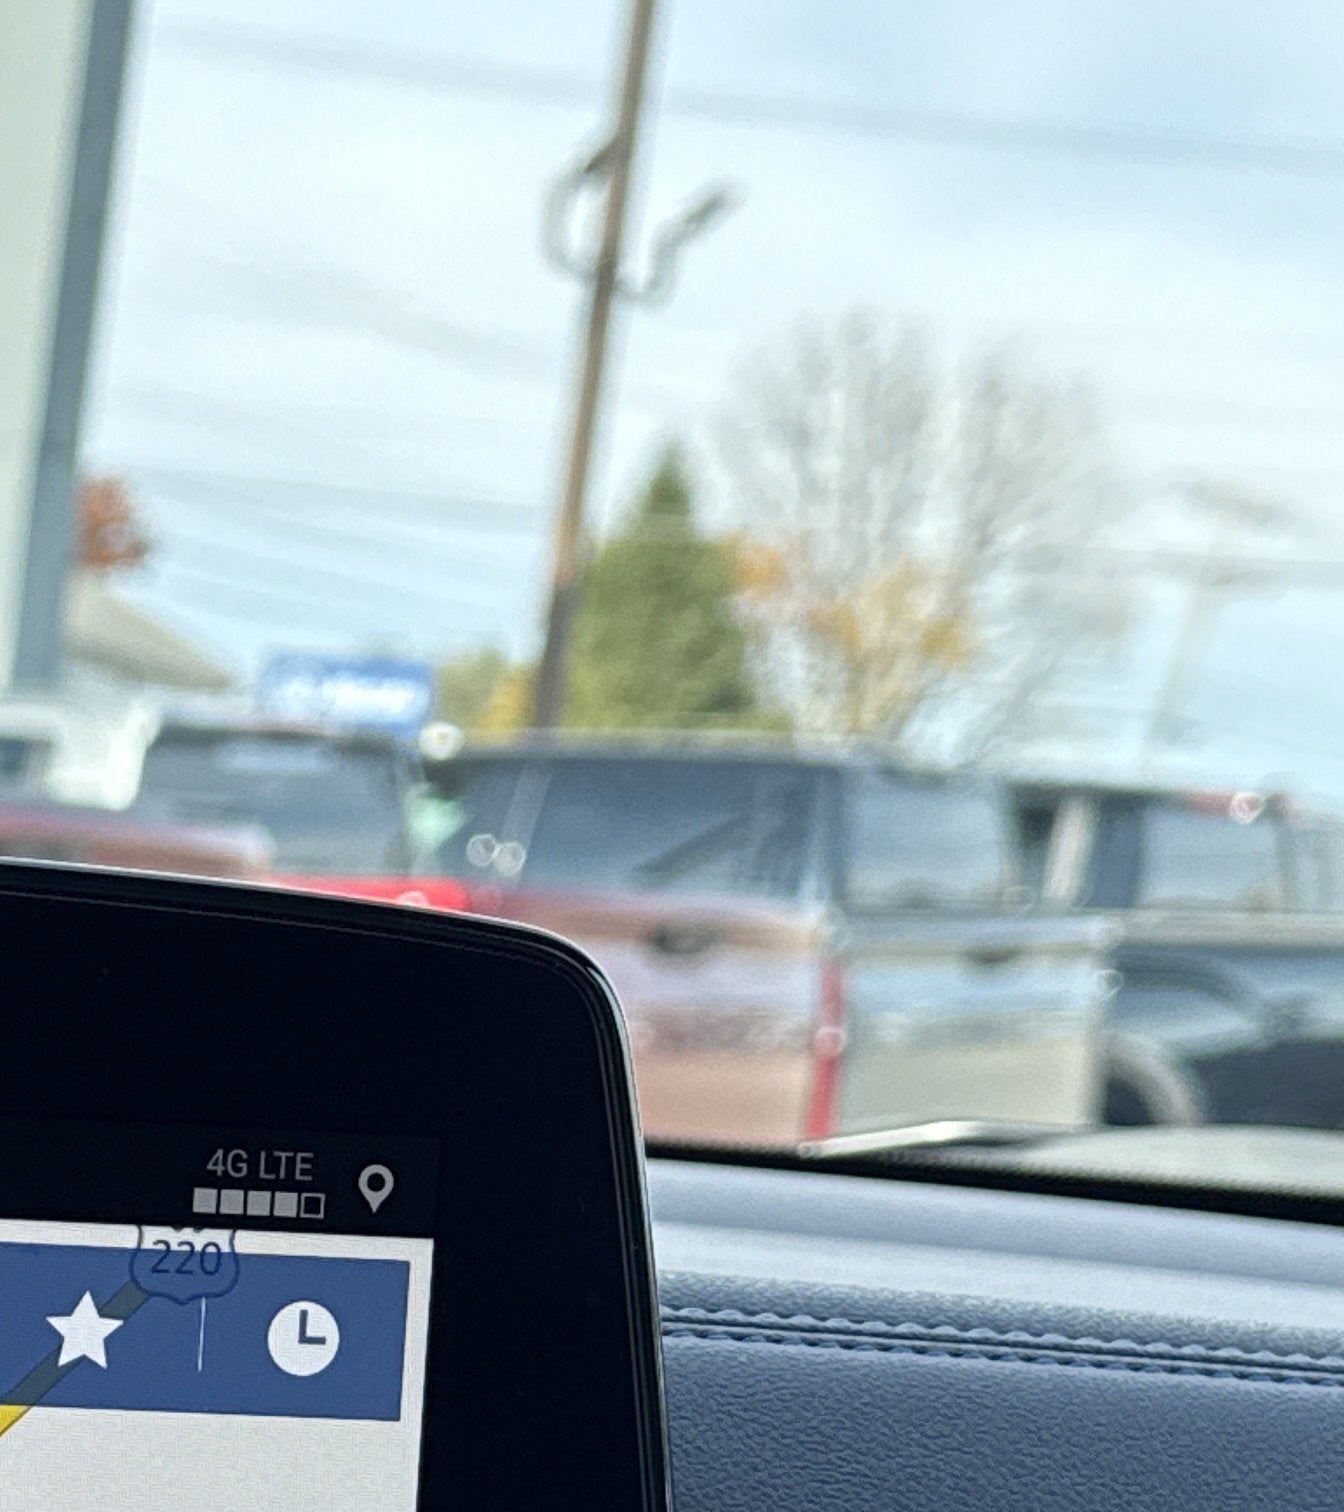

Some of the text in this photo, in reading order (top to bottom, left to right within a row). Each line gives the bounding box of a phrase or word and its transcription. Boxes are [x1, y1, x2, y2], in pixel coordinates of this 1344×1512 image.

[206, 1148, 315, 1182] 4G LTE
[150, 1239, 222, 1276] 220
